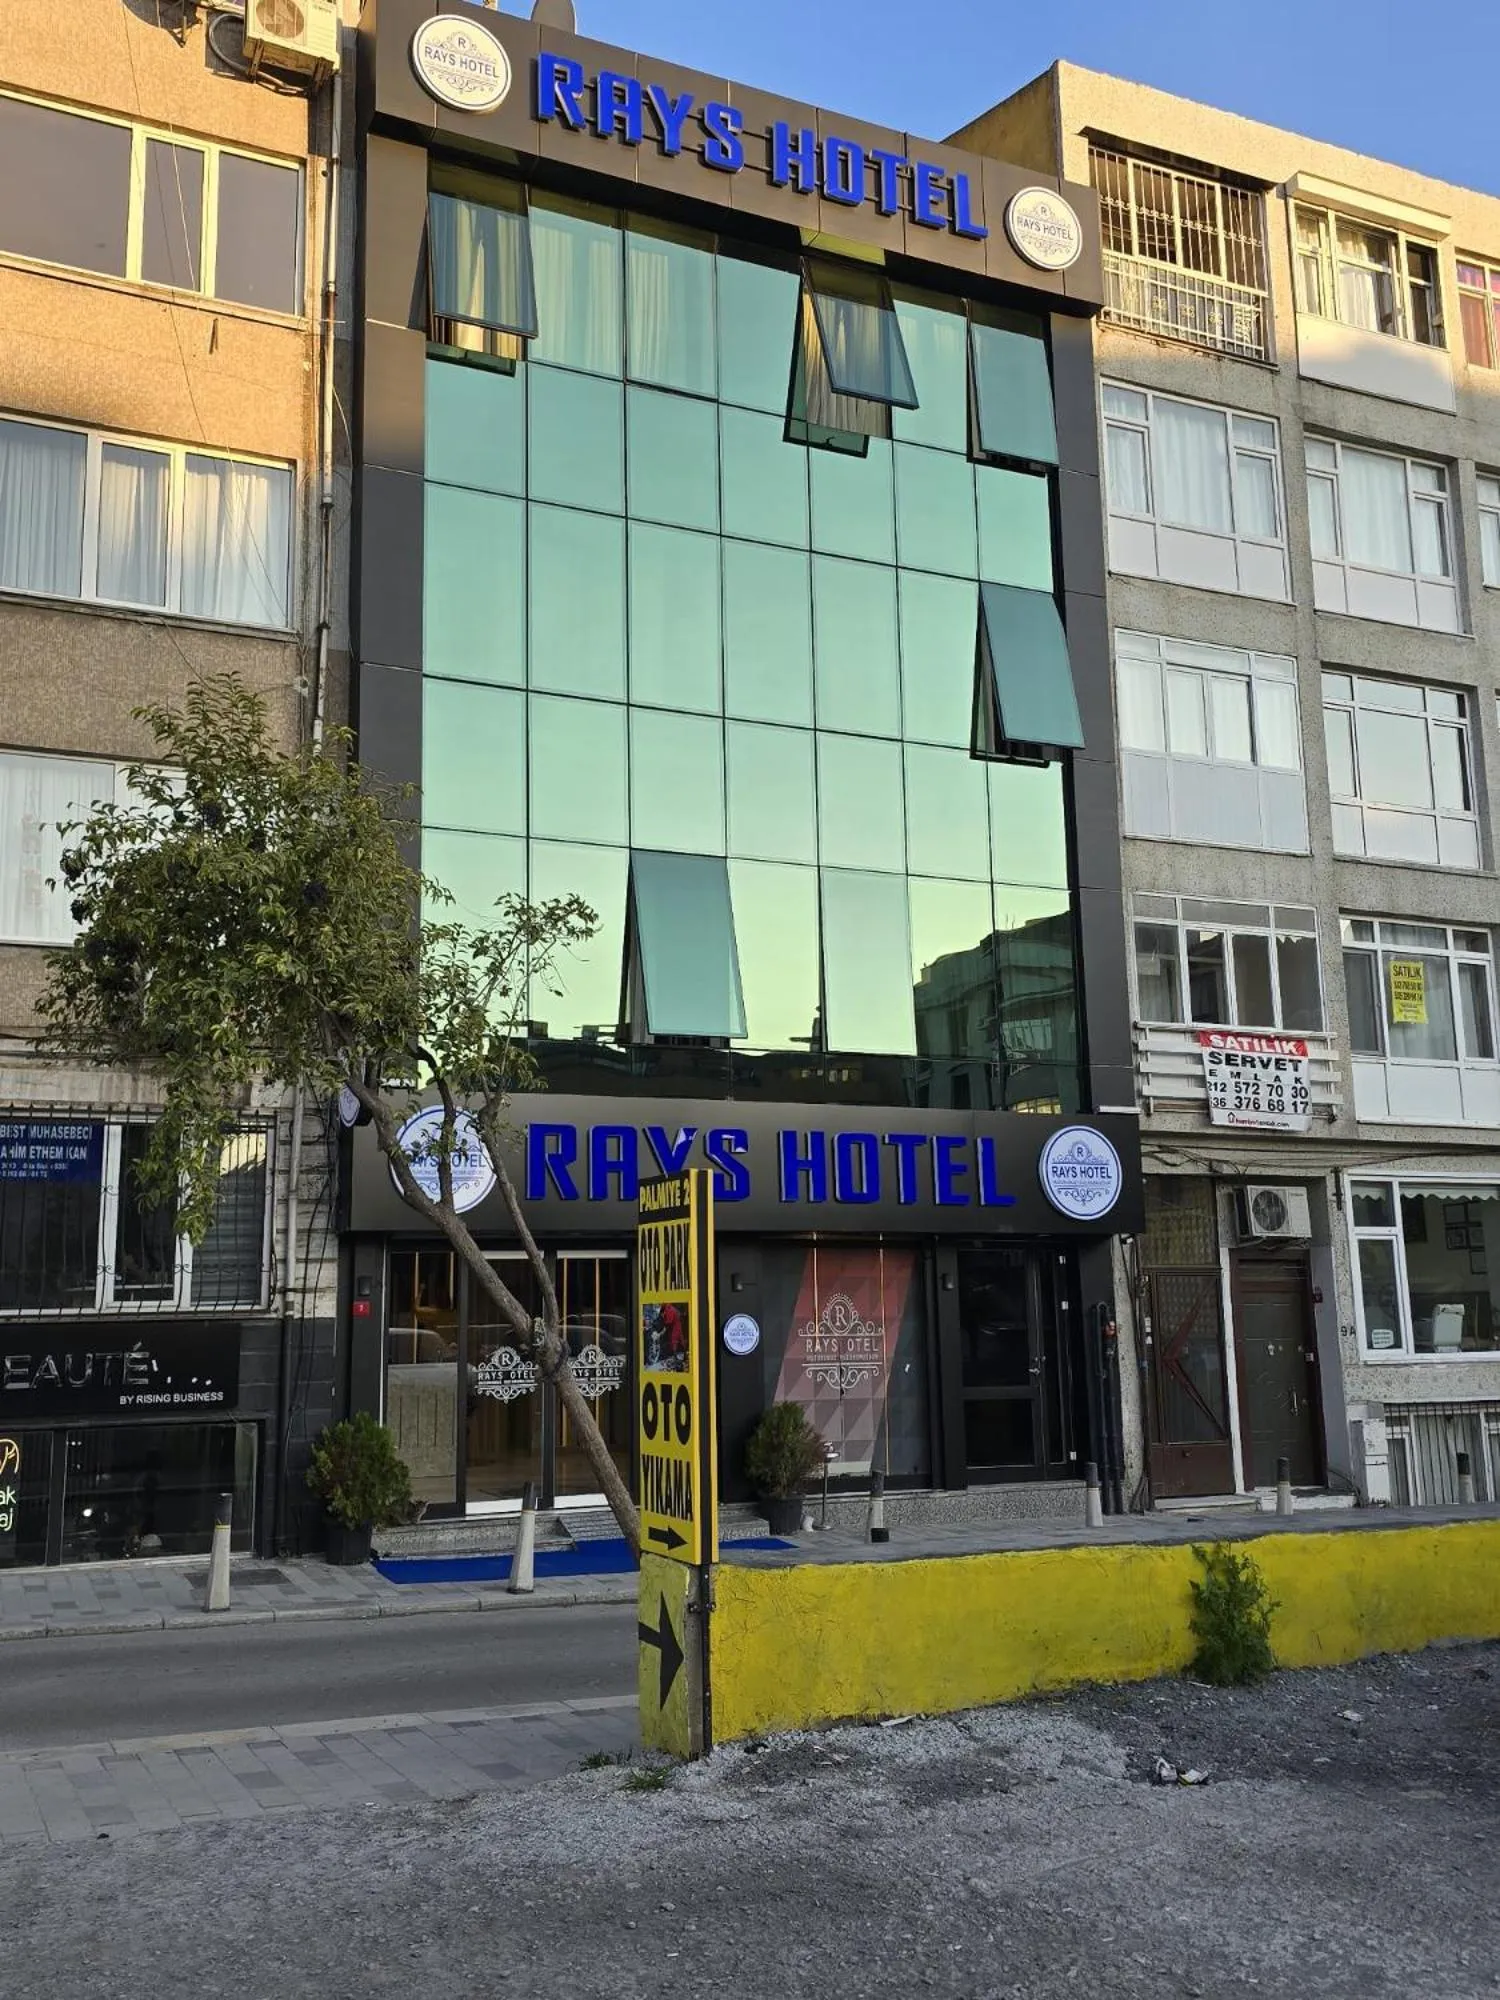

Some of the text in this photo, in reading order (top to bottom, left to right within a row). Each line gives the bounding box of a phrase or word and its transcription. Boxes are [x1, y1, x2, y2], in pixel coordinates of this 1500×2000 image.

[424, 45, 456, 66] RAYS
[460, 56, 501, 79] HOTEL
[537, 52, 989, 240] RAYS HOTEL
[1017, 215, 1041, 232] RAYS
[1043, 224, 1074, 241] HOTEL
[1208, 1051, 1303, 1073] SERVET
[1234, 1081, 1260, 1096] 572
[1266, 1083, 1284, 1098] 70
[1291, 1086, 1309, 1100] 30
[1211, 1095, 1309, 1114] 36 376 68 17
[29, 1145, 64, 1160] ETHEM
[409, 1153, 487, 1168] AYS OTEL
[1076, 1146, 1084, 1158] R
[526, 1123, 1018, 1206] RAYS HOTEL
[1051, 1165, 1113, 1179] RAYS HOTEL
[683, 1178, 690, 1206] 2
[640, 1222, 691, 1293] OTO PARK
[834, 1304, 848, 1326] R
[805, 1338, 879, 1353] RAYS OTEL
[4, 1340, 150, 1390] EAUTÉ
[501, 1353, 511, 1366] R
[588, 1350, 597, 1363] R
[478, 1370, 535, 1380] RAYS OTEL
[595, 1367, 620, 1377] OTEL
[119, 1391, 224, 1405] BY RISING BUSINESS
[642, 1382, 691, 1445] OTO
[641, 1453, 694, 1523] YIKAMA
